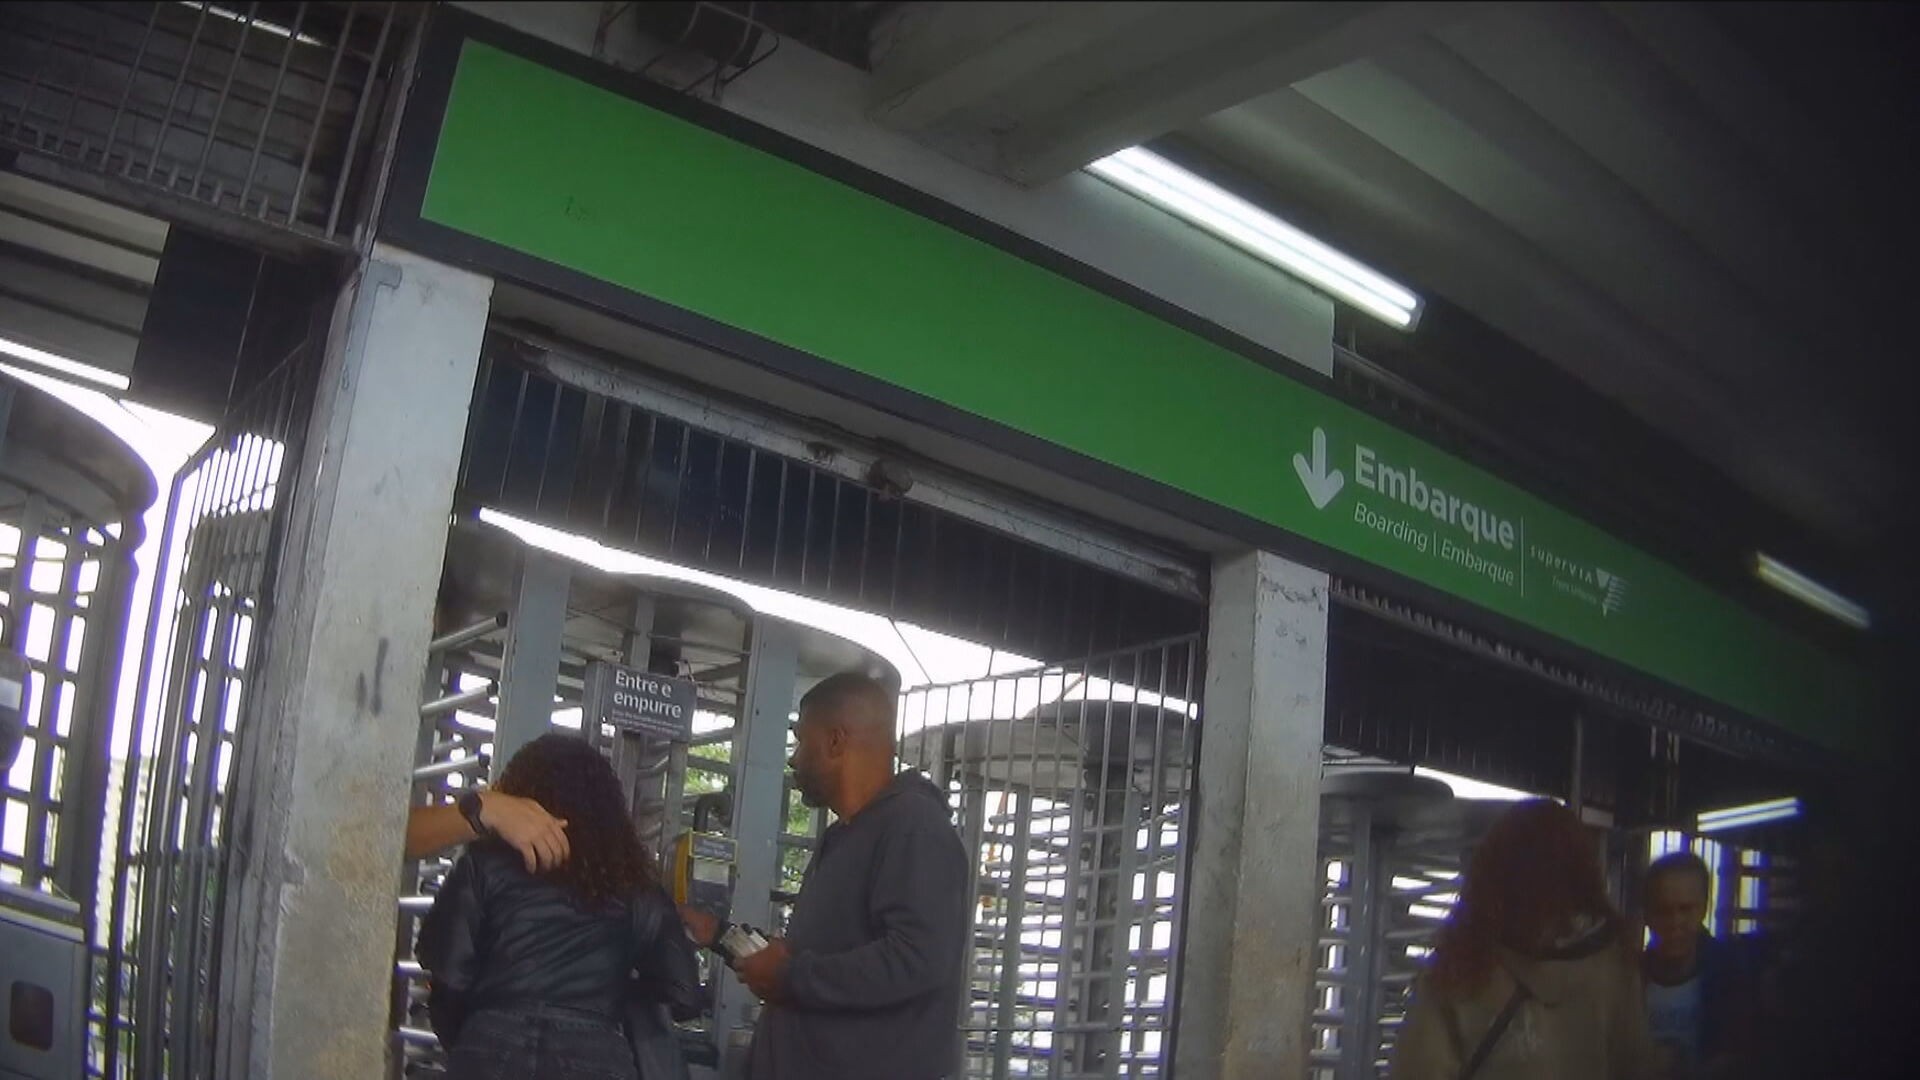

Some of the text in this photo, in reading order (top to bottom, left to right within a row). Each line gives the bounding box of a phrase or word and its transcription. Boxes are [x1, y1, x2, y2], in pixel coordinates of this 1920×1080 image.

[1355, 443, 1515, 550] Embarque
[1354, 501, 1515, 586] Boarding Embarque
[613, 691, 682, 718] empurre
[615, 669, 672, 698] Entre e
